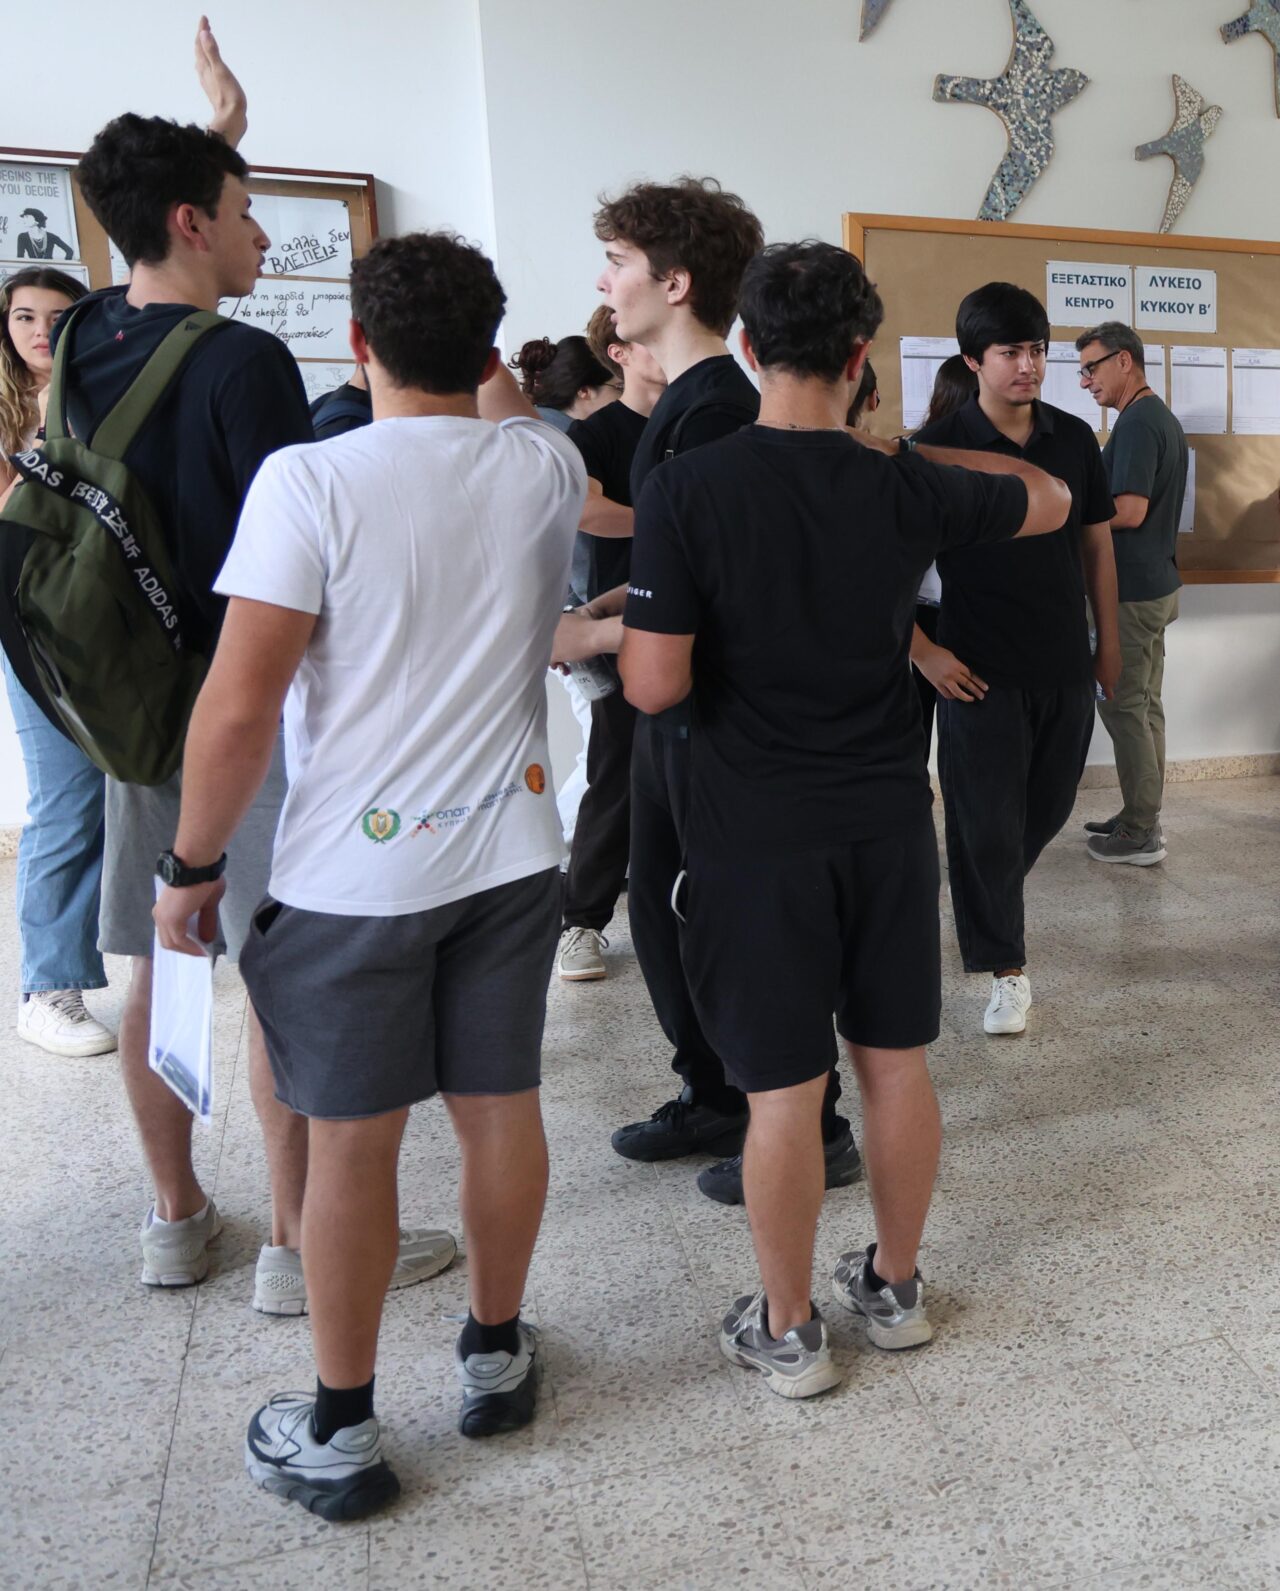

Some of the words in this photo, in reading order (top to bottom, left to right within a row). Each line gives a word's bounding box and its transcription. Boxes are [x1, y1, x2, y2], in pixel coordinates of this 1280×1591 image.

[0, 170, 31, 182] EGINS
[36, 172, 57, 185] THE
[0, 184, 20, 195] YOU
[25, 185, 59, 198] DECIDE
[328, 229, 350, 243] δεν
[268, 244, 339, 274] ΒΛΕΠΕΙΣ
[1051, 273, 1127, 288] ΕΞΕΤΑΣΤΙΚΟ
[1149, 275, 1202, 290] ΛΥΚΕΙΟ
[1065, 297, 1114, 310] ΚΕΝΤΡΟ
[1140, 300, 1195, 315] ΚΥΚΚΟΥ
[134, 567, 179, 629] ADIDAS
